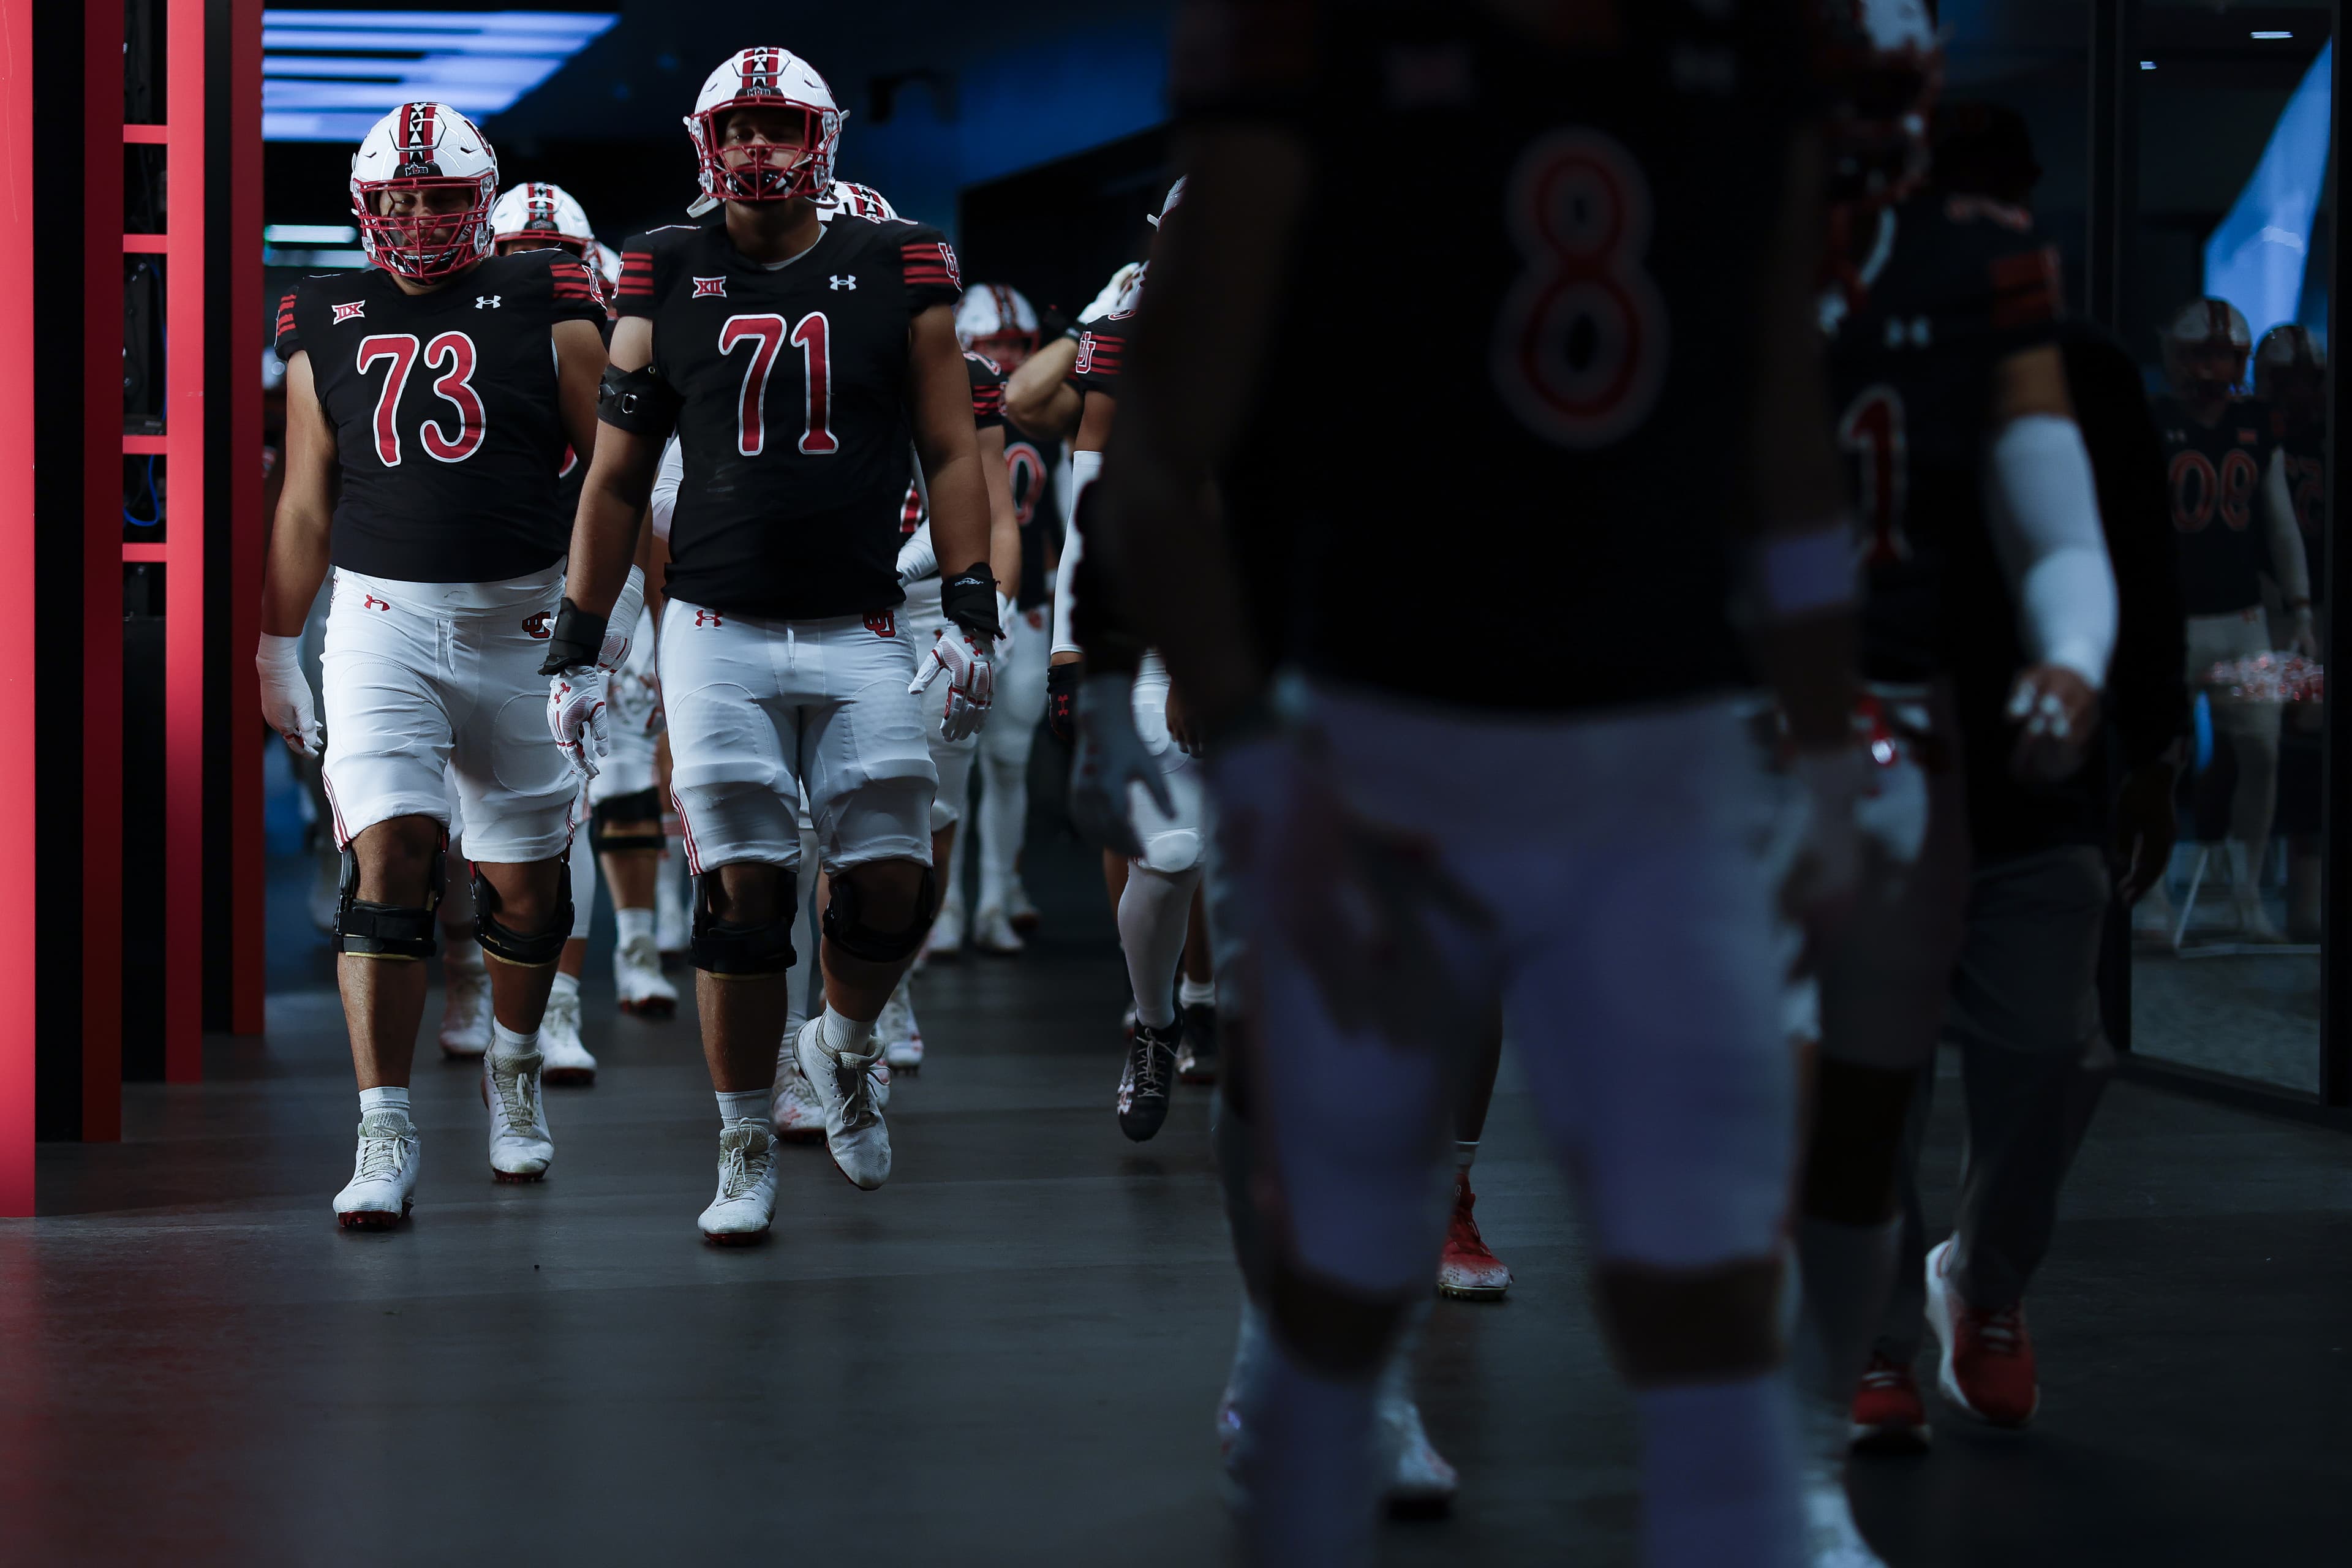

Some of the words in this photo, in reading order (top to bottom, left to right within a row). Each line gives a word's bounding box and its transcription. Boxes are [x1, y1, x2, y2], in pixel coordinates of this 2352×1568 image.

[1492, 126, 1672, 450] 8
[356, 330, 486, 467] 73
[718, 311, 839, 456] 71
[1838, 382, 1915, 565] 1
